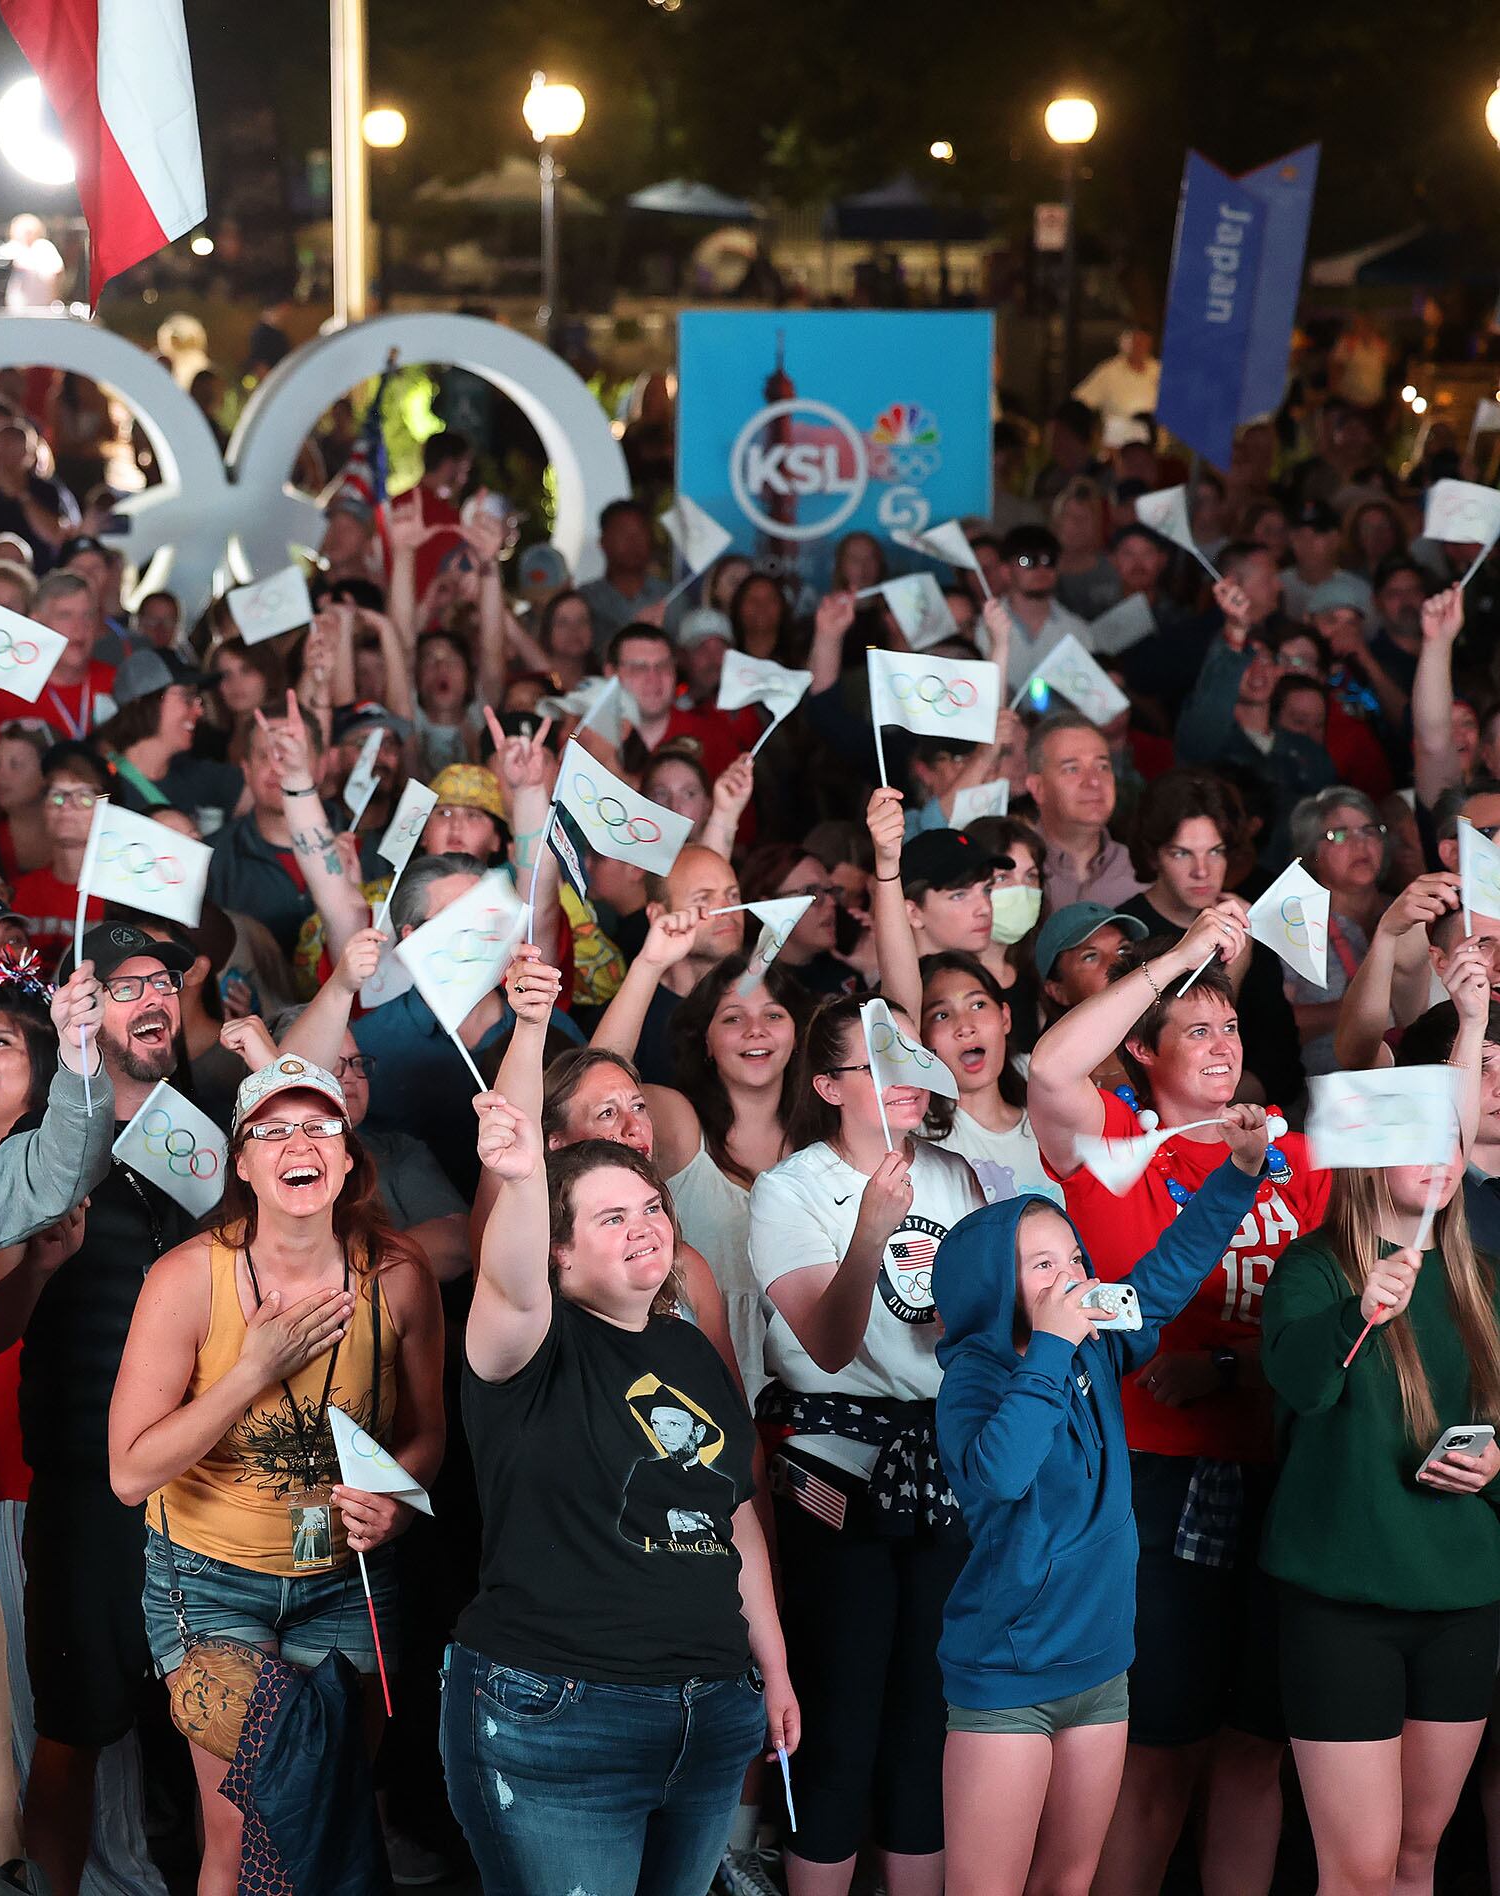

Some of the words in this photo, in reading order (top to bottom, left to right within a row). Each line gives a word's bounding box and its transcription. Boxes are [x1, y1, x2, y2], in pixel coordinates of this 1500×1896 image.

[1205, 203, 1253, 323] Japan
[748, 446, 858, 495] KSL
[1228, 1187, 1300, 1249] SA
[888, 1295, 929, 1321] OLYMPIC
